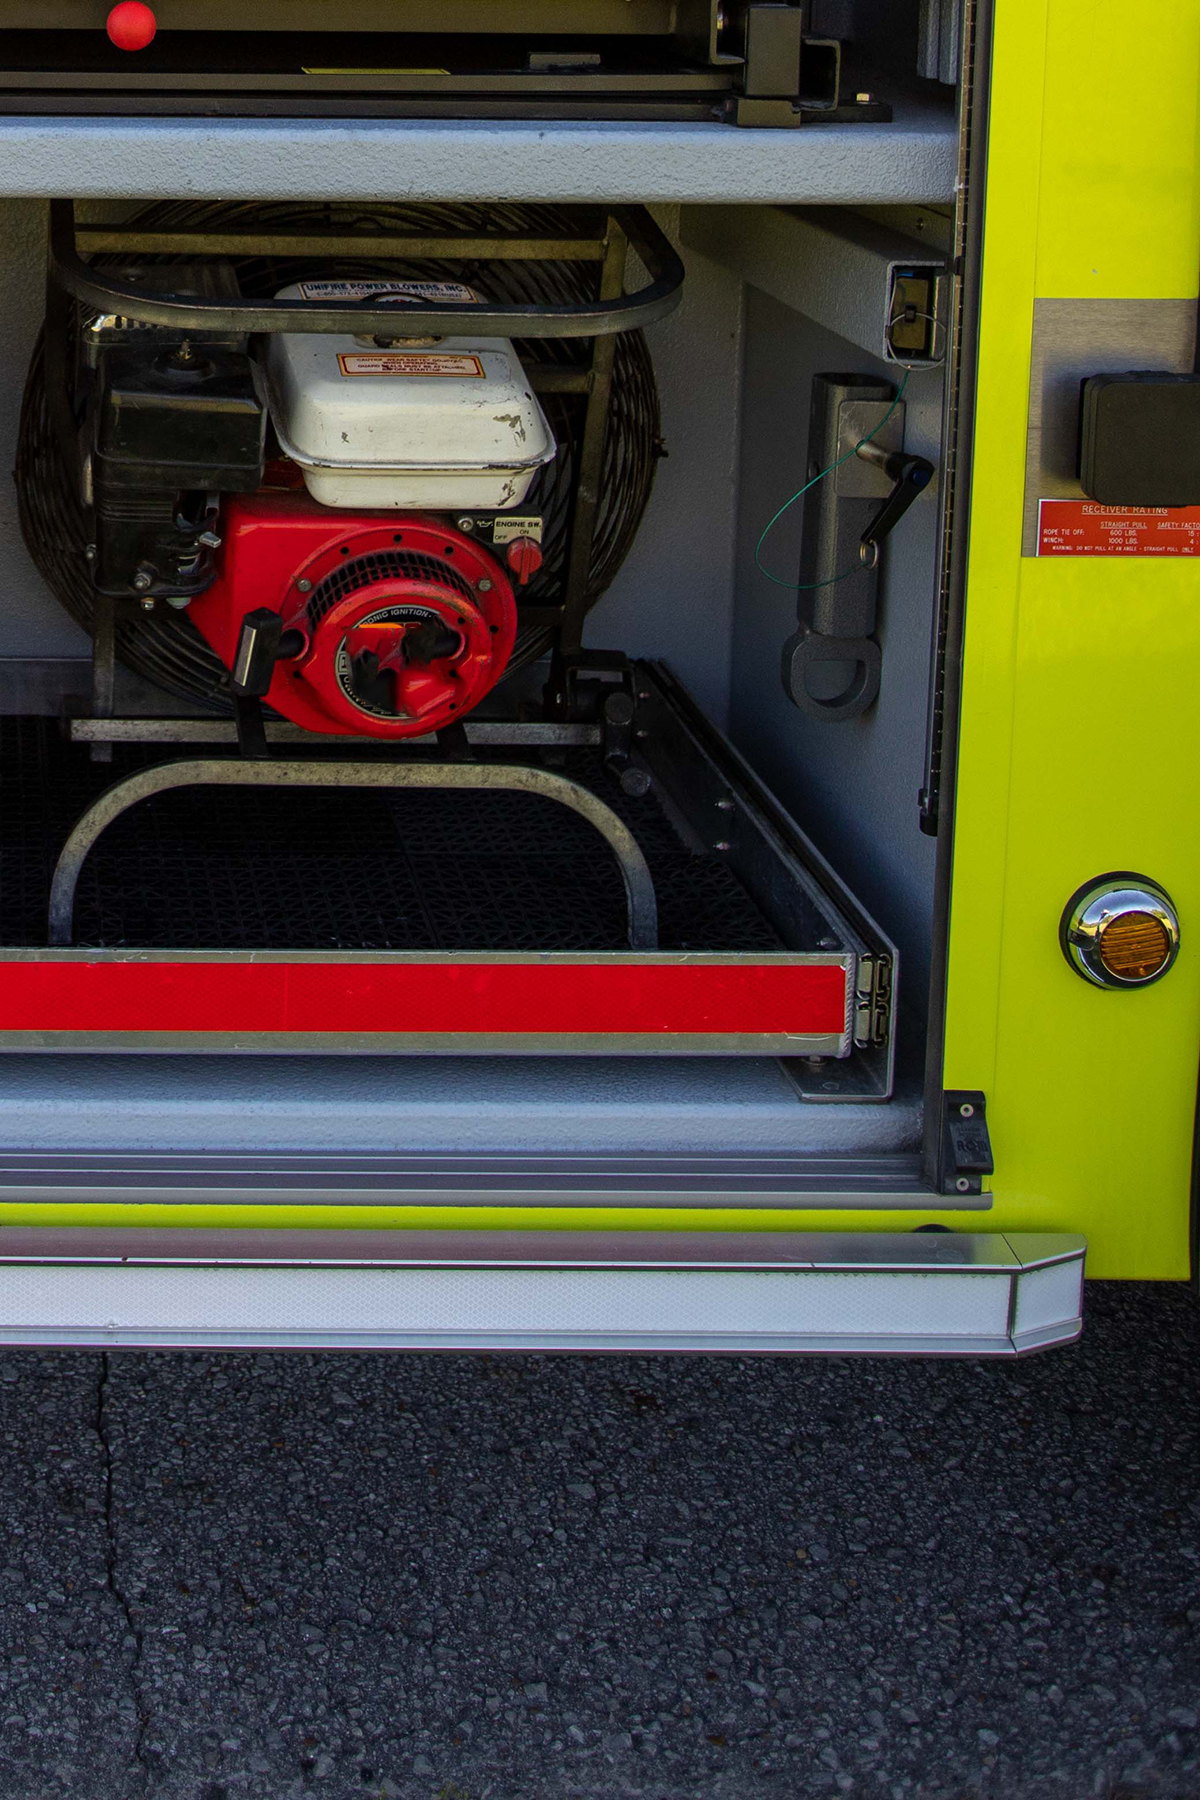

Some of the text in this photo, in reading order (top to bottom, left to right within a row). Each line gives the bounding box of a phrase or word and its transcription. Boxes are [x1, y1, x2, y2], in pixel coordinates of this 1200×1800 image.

[307, 282, 347, 291] UNIFIRE
[350, 282, 387, 290] POWER
[445, 284, 466, 292] INC.
[1082, 505, 1128, 513] RECEIVER
[391, 608, 429, 618] IGNITION
